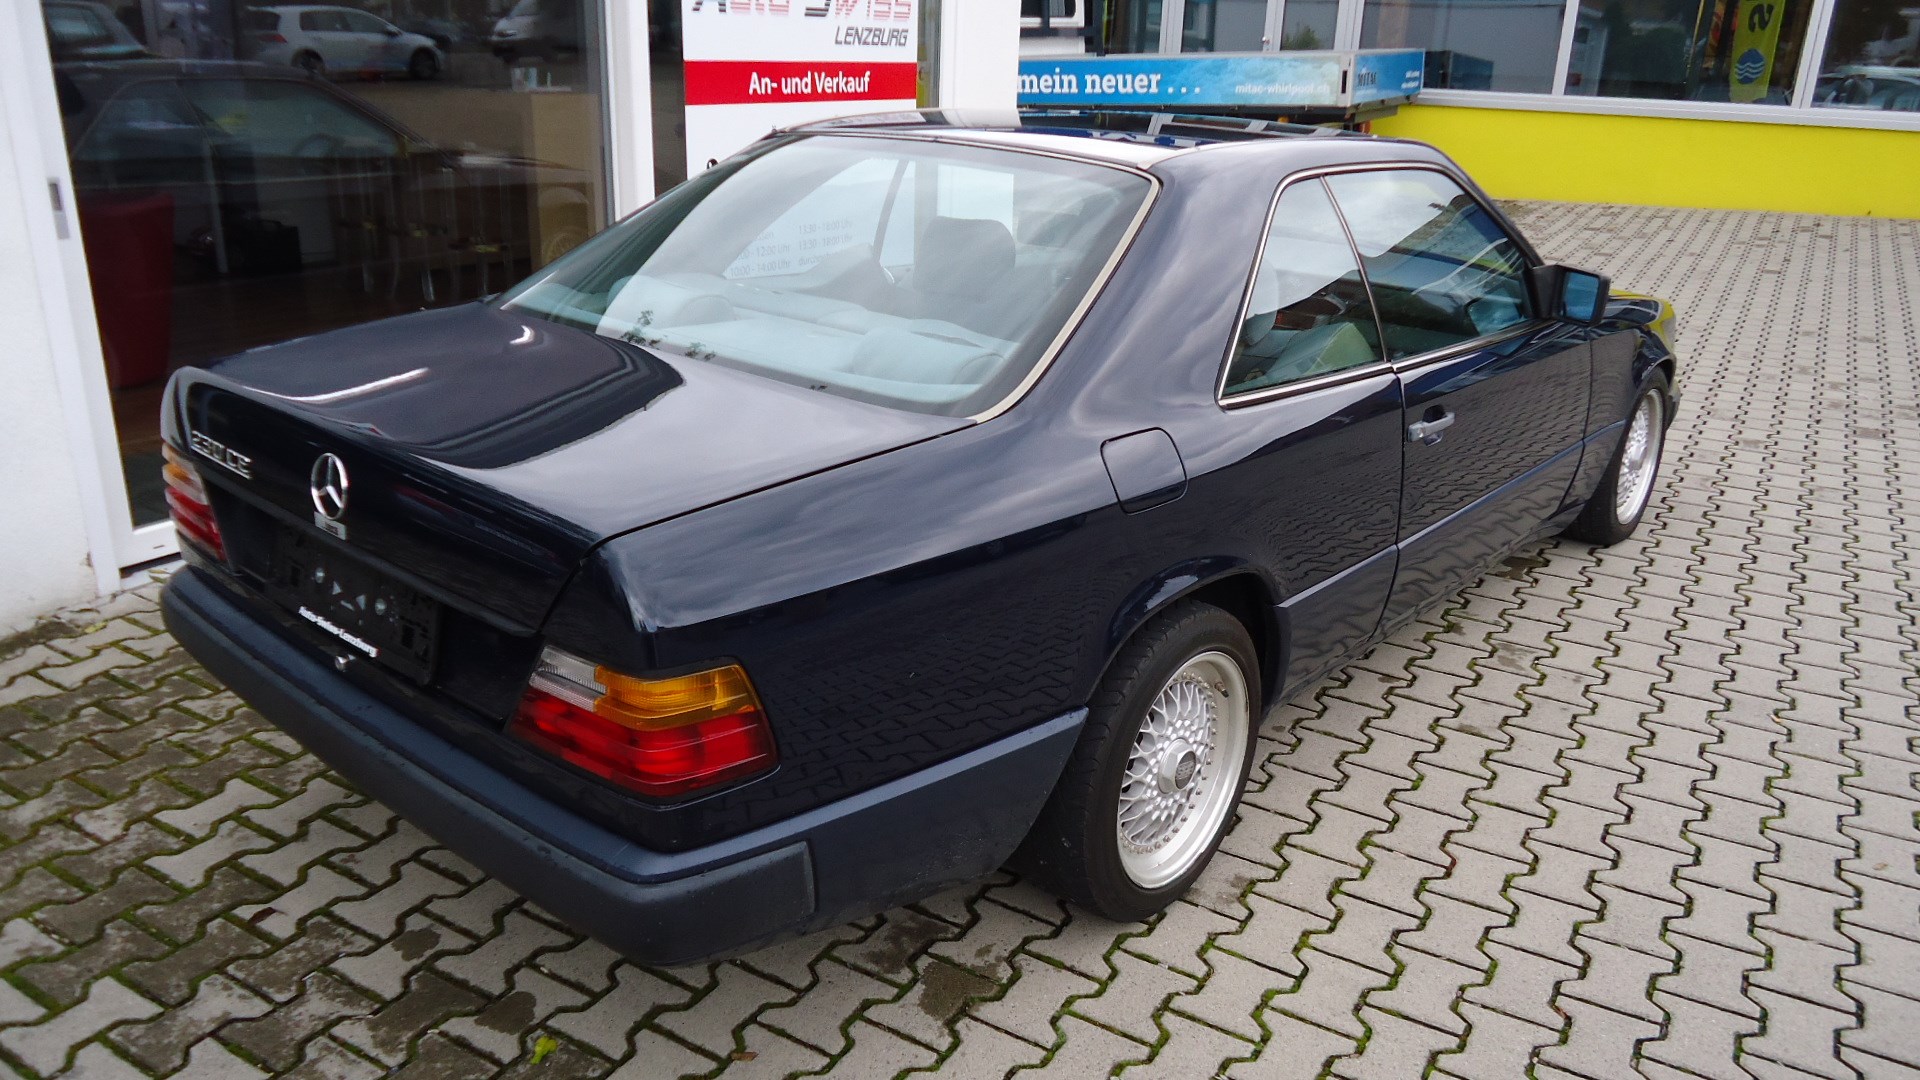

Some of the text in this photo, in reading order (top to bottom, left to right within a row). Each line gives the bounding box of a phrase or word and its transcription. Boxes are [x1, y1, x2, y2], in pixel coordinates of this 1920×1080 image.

[834, 26, 909, 47] LENZBURG
[748, 70, 871, 95] An- und Verkauf
[1017, 67, 1079, 94] mein
[1084, 73, 1162, 94] neuer
